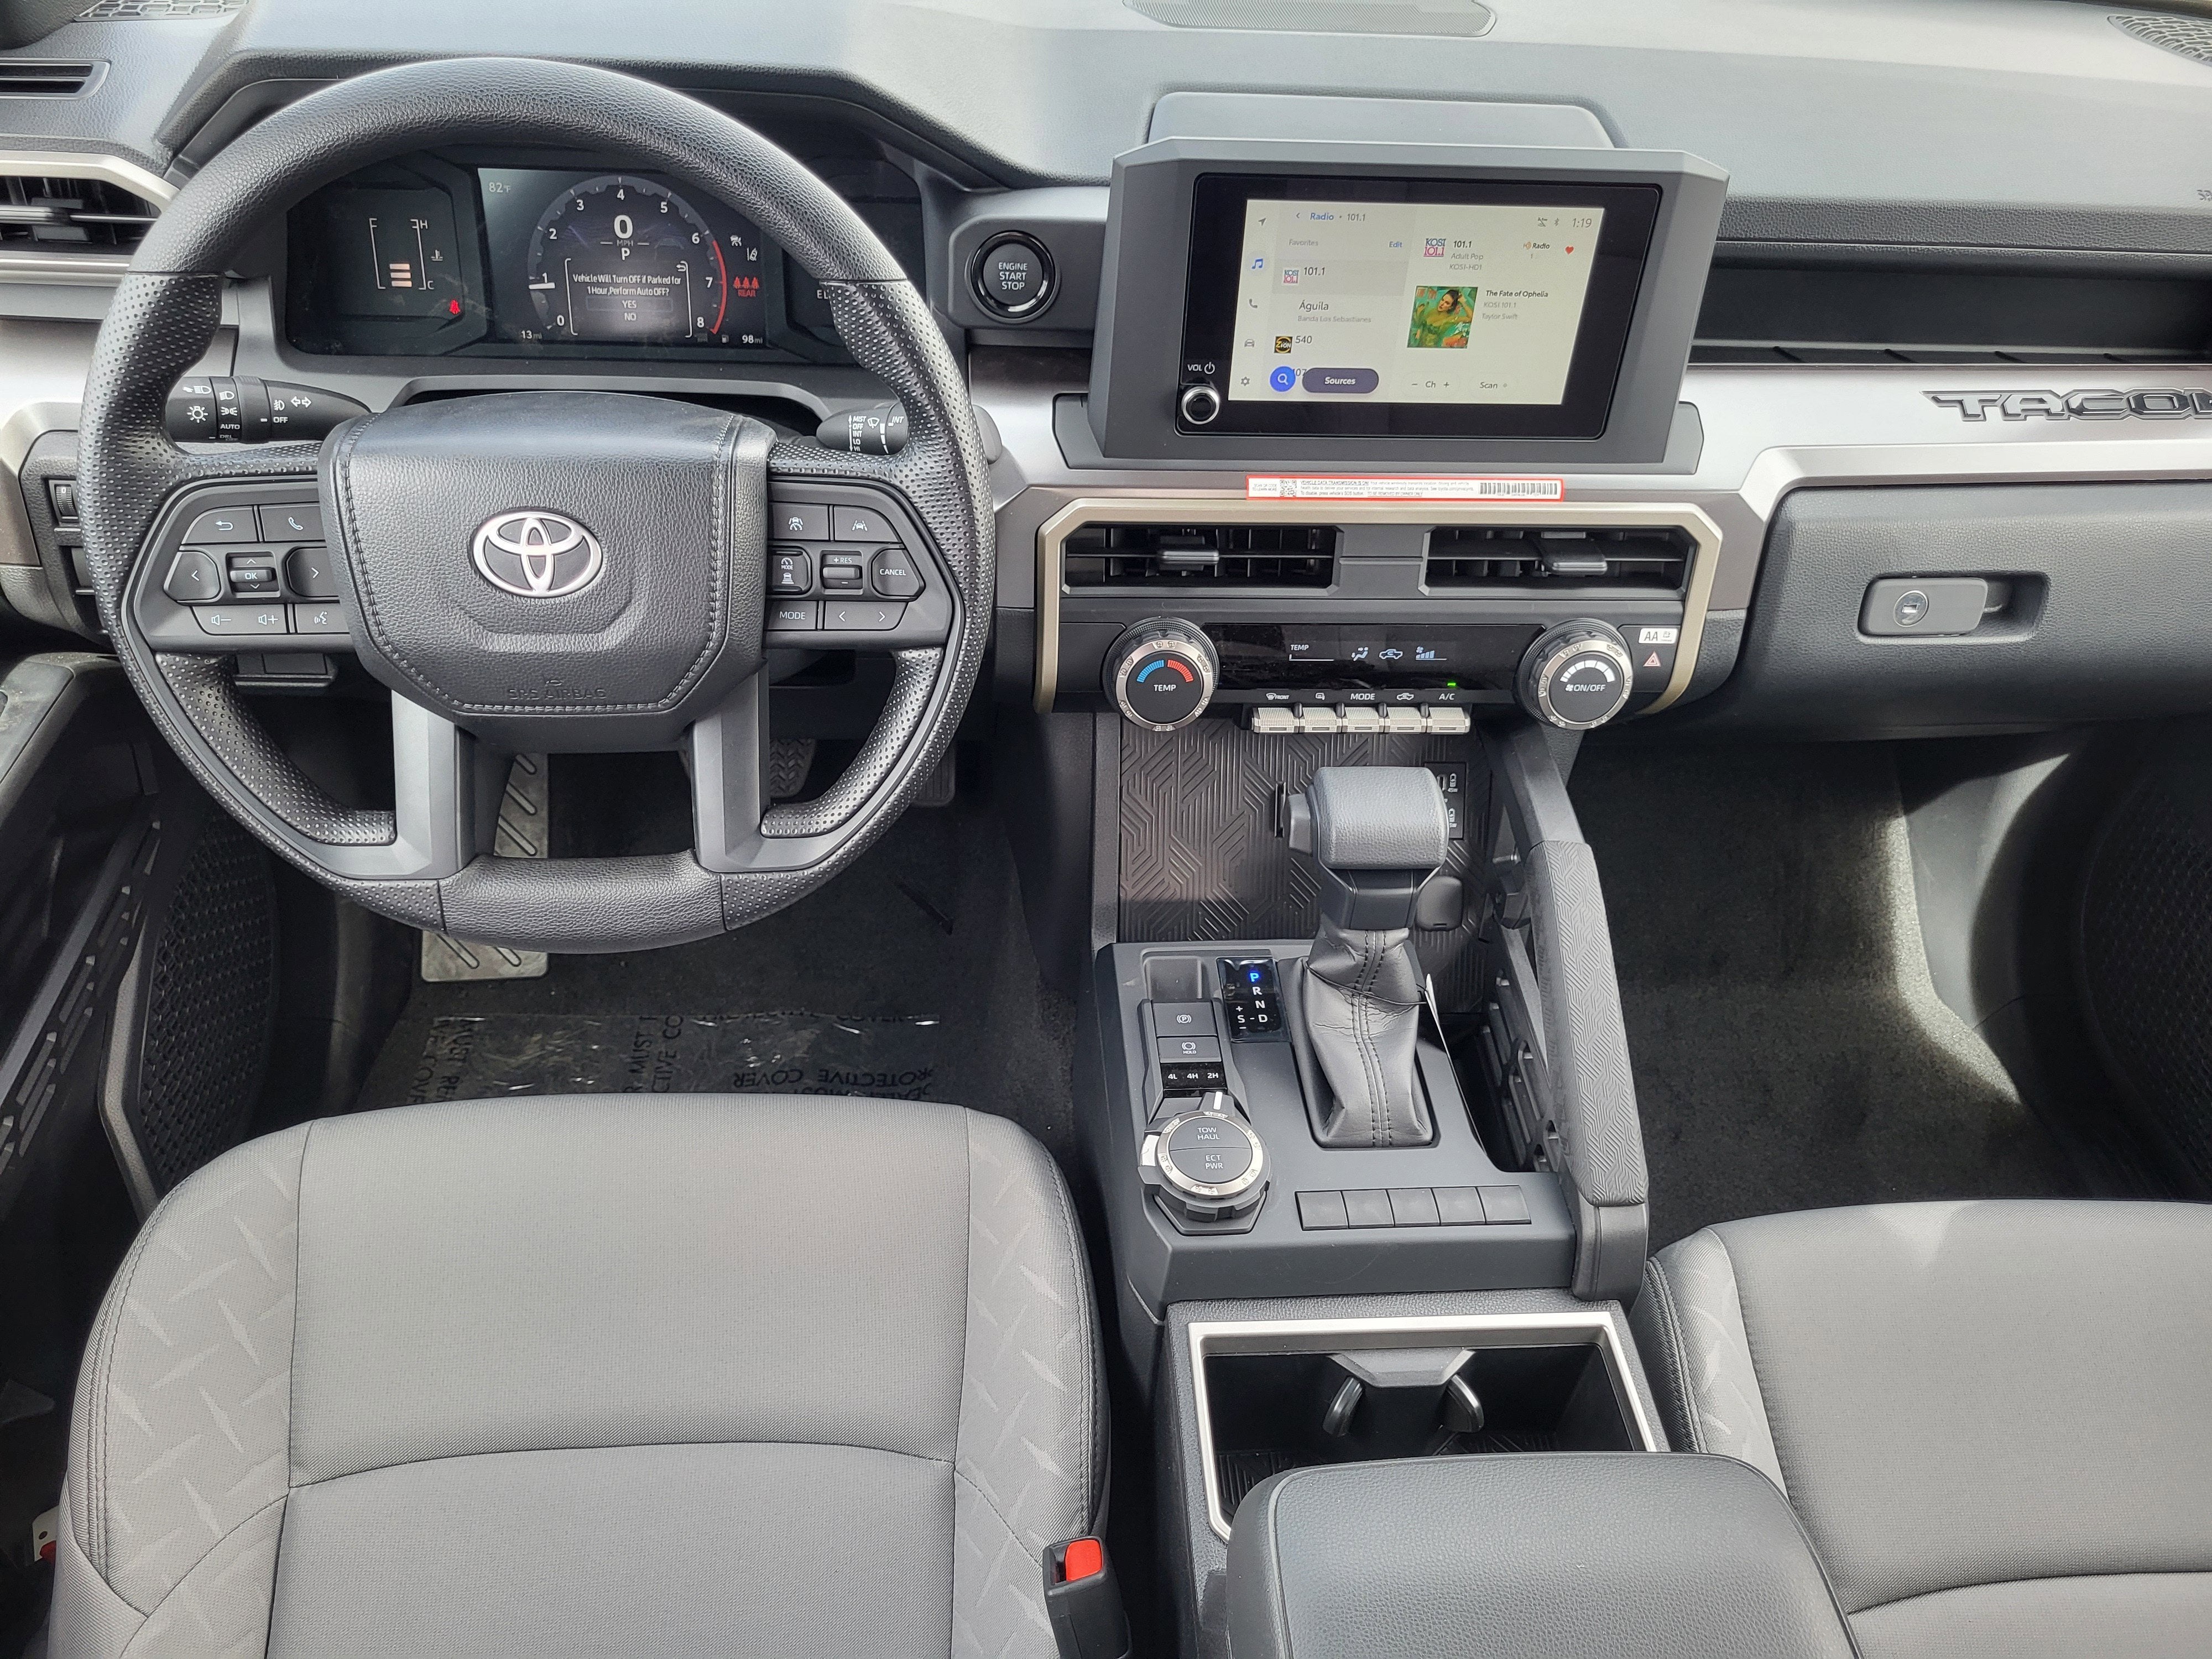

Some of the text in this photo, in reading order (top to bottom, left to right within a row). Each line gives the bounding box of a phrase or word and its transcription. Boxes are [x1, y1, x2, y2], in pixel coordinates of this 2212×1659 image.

[617, 190, 624, 200] 4
[576, 200, 585, 210] 3
[660, 202, 667, 213] 5
[614, 215, 633, 239] 0
[1572, 218, 1592, 228] 1:19
[549, 229, 557, 239] 2
[692, 233, 700, 244] 6
[1425, 238, 1446, 247] KOSI
[622, 247, 630, 260] P
[1423, 247, 1444, 257] 101.1
[998, 262, 1027, 270] ENGINE
[999, 272, 1026, 280] START
[1303, 267, 1325, 276] 101.1
[542, 273, 548, 283] 1
[573, 274, 597, 283] Vehicle
[598, 274, 611, 283] Will
[612, 275, 628, 283] Turn
[629, 275, 640, 284] OFF
[648, 275, 670, 284] Parked
[672, 276, 681, 285] for
[706, 277, 713, 288] 7
[427, 281, 434, 289] C
[1001, 281, 1025, 290] STOP
[622, 300, 637, 309] YES
[1299, 300, 1329, 312] Águila
[557, 315, 565, 326] 0
[697, 317, 705, 327] 8
[1295, 336, 1312, 344] 540
[1324, 377, 1356, 385] Sources
[779, 611, 806, 619] MODE
[1644, 632, 1658, 641] AA
[1154, 684, 1176, 692] TEMP
[1574, 684, 1606, 692] ON/OFF
[544, 689, 607, 700] AIRBAG
[1350, 692, 1375, 701] MODE
[1438, 692, 1455, 701] A/C
[1250, 973, 1260, 982] P
[1252, 987, 1262, 995] R
[1255, 1000, 1265, 1009] N
[1237, 1014, 1268, 1023] S D
[733, 1068, 804, 1088] COVER
